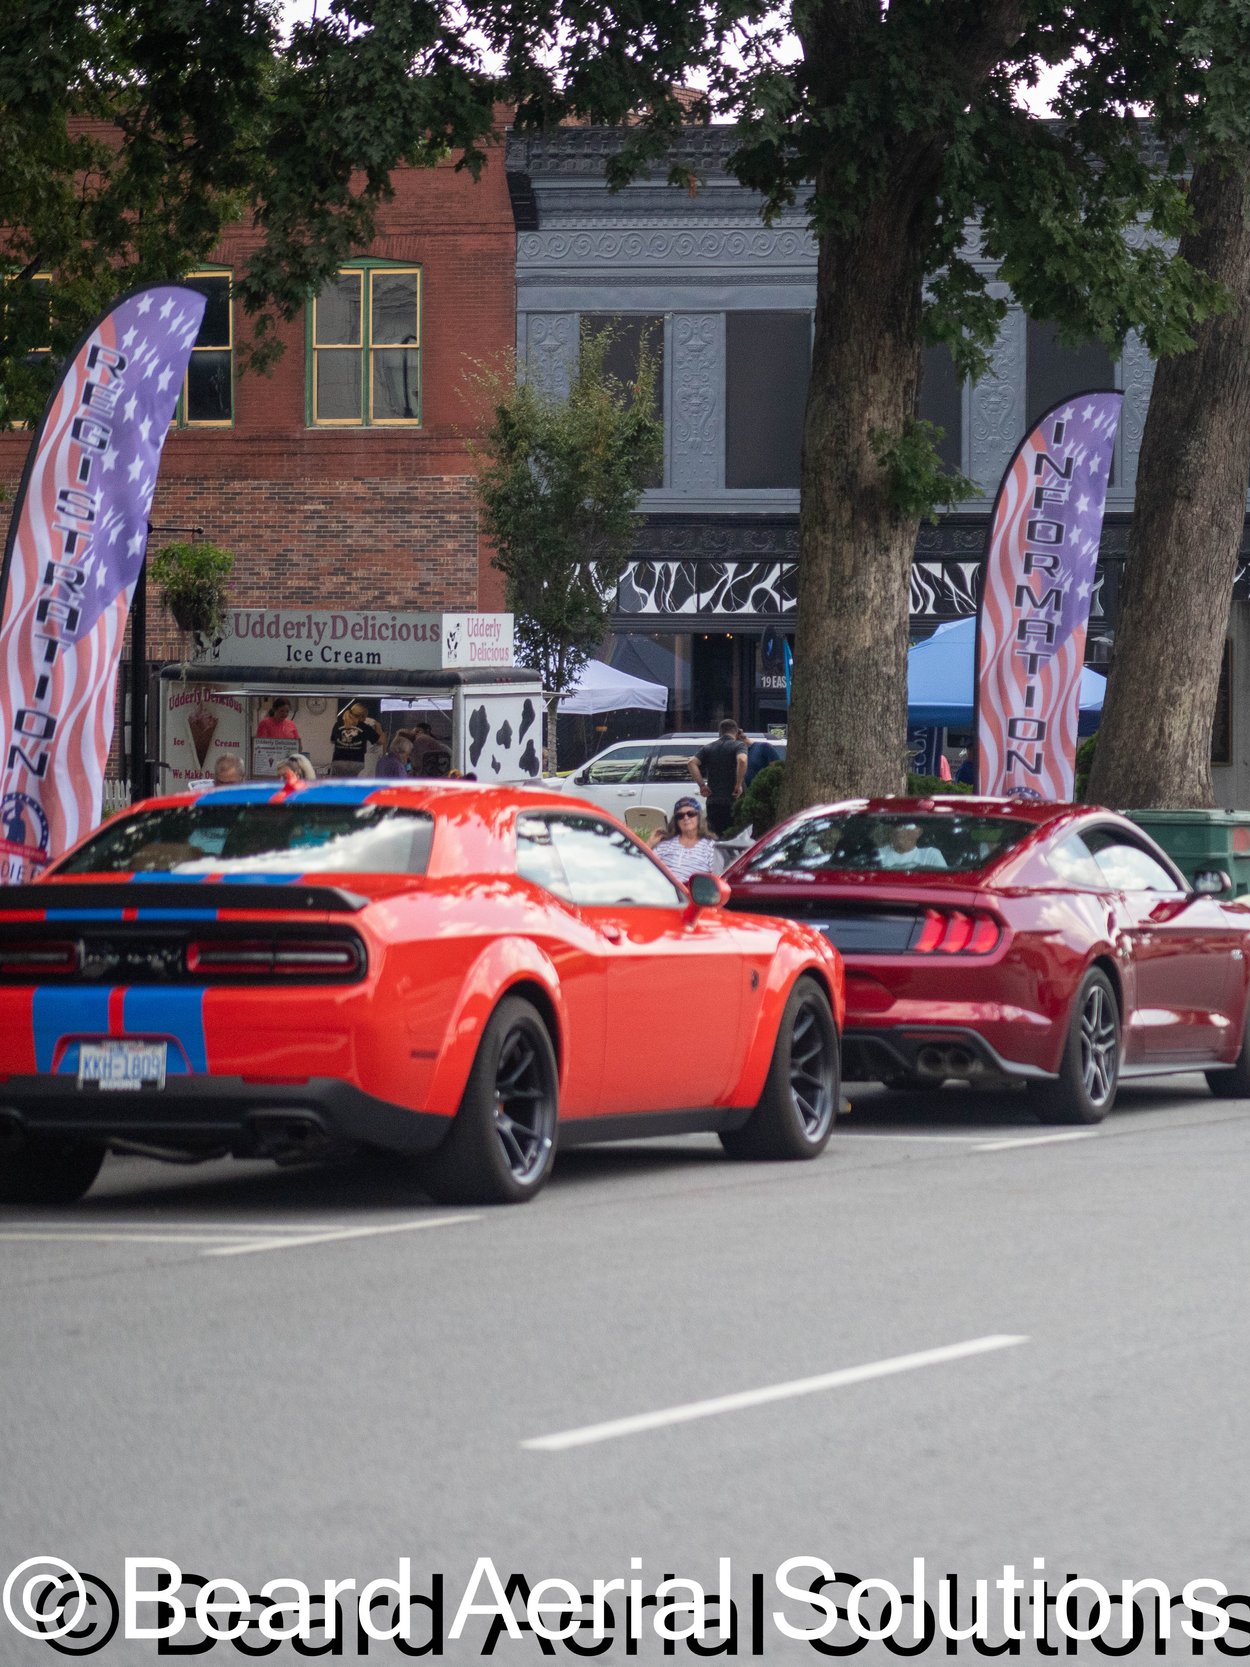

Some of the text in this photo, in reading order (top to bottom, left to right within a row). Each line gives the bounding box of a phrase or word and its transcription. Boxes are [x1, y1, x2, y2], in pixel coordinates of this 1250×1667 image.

[7, 344, 128, 779] REGISTRATION
[1003, 419, 1073, 775] INFORMATION
[233, 612, 441, 646] Udderly Delicious
[467, 617, 502, 642] Udderly
[286, 644, 382, 664] Ice Cream
[470, 642, 509, 662] Delicious
[761, 676, 787, 688] 19 EAS
[173, 738, 240, 748] Ice Cream
[172, 769, 183, 779] We
[185, 769, 203, 779] Make
